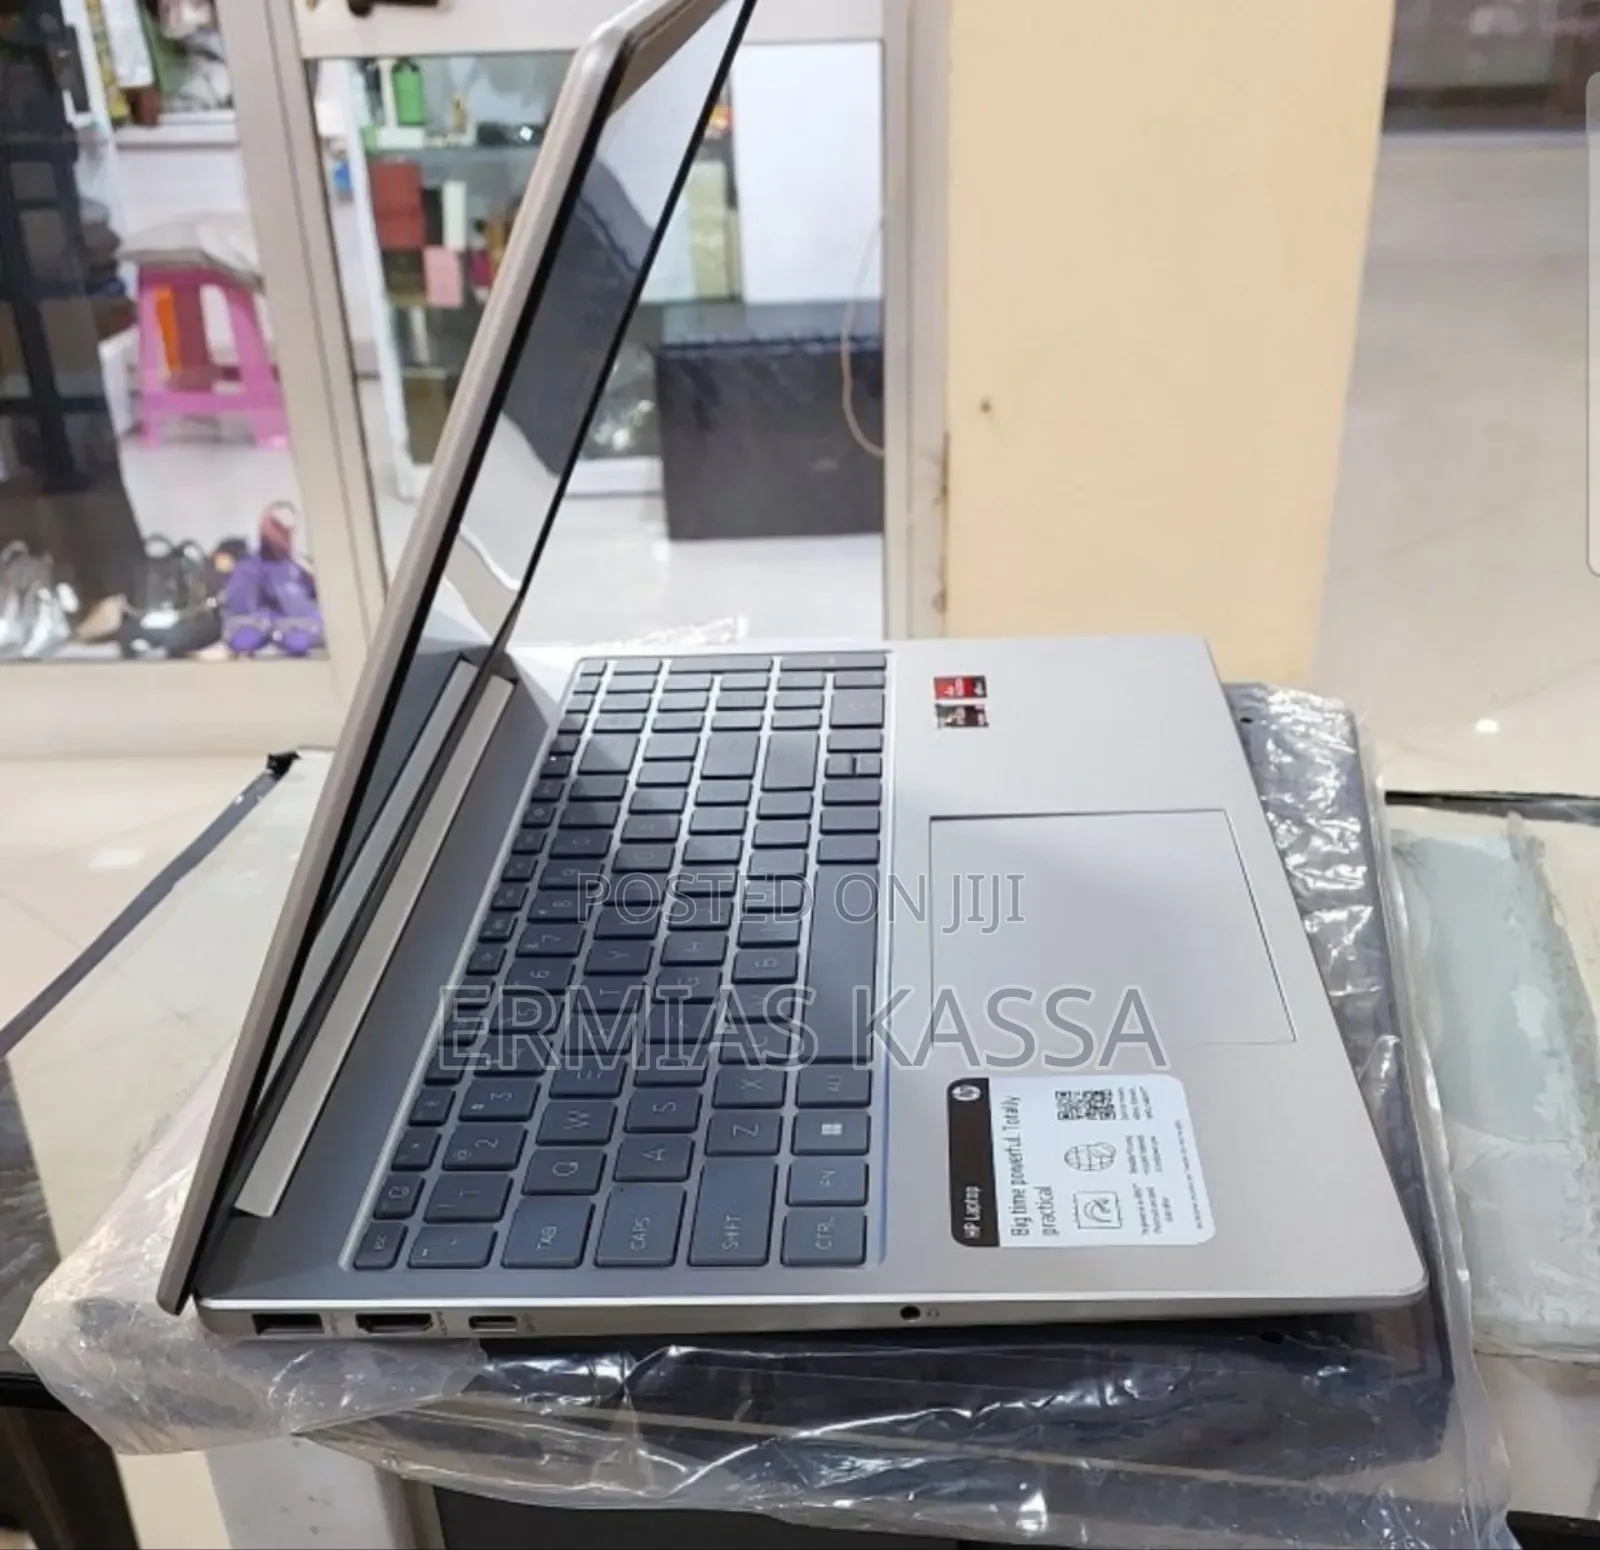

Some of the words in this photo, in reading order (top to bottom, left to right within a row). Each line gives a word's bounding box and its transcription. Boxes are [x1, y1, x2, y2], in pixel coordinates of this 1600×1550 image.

[740, 1078, 763, 1091] X
[489, 1092, 512, 1102] 3
[652, 1101, 677, 1113] S
[563, 1109, 592, 1131] W
[1001, 1095, 1021, 1132] Totally
[732, 1123, 759, 1137] Z
[474, 1136, 499, 1149] 2
[640, 1147, 667, 1162] A
[551, 1160, 579, 1177] Q
[963, 1185, 983, 1221] Laptop
[1008, 1188, 1028, 1214] time
[1033, 1185, 1060, 1237] practical
[629, 1215, 651, 1251] CAPS
[721, 1213, 744, 1250] SHIFT
[814, 1214, 835, 1250] CTRL
[963, 1222, 981, 1239] HP
[1010, 1215, 1033, 1237] Big
[535, 1225, 558, 1251] TAB
